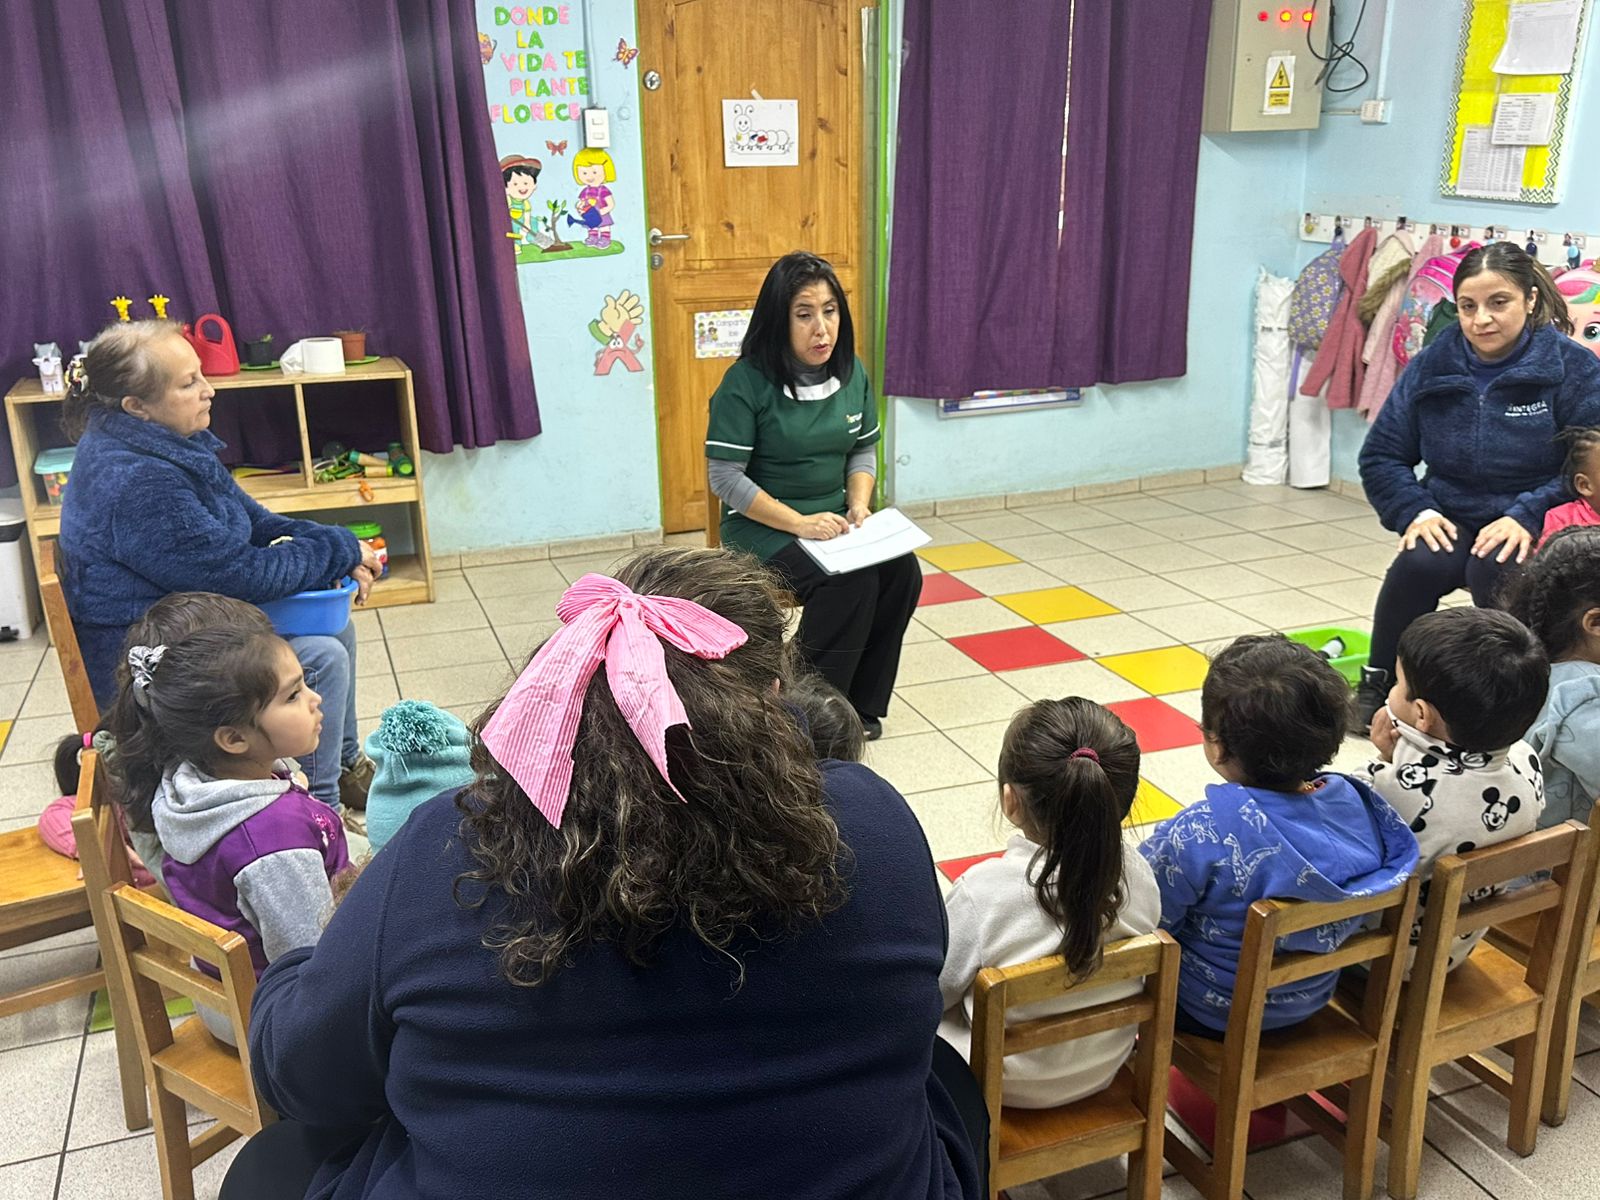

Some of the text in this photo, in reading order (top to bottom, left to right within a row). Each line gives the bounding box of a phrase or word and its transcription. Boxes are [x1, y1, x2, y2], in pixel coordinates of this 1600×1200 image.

[495, 5, 570, 26] DONDE
[516, 30, 544, 49] LA
[501, 50, 588, 72] VIDA TE
[510, 77, 589, 97] PLANTE
[491, 102, 581, 124] FLORECE
